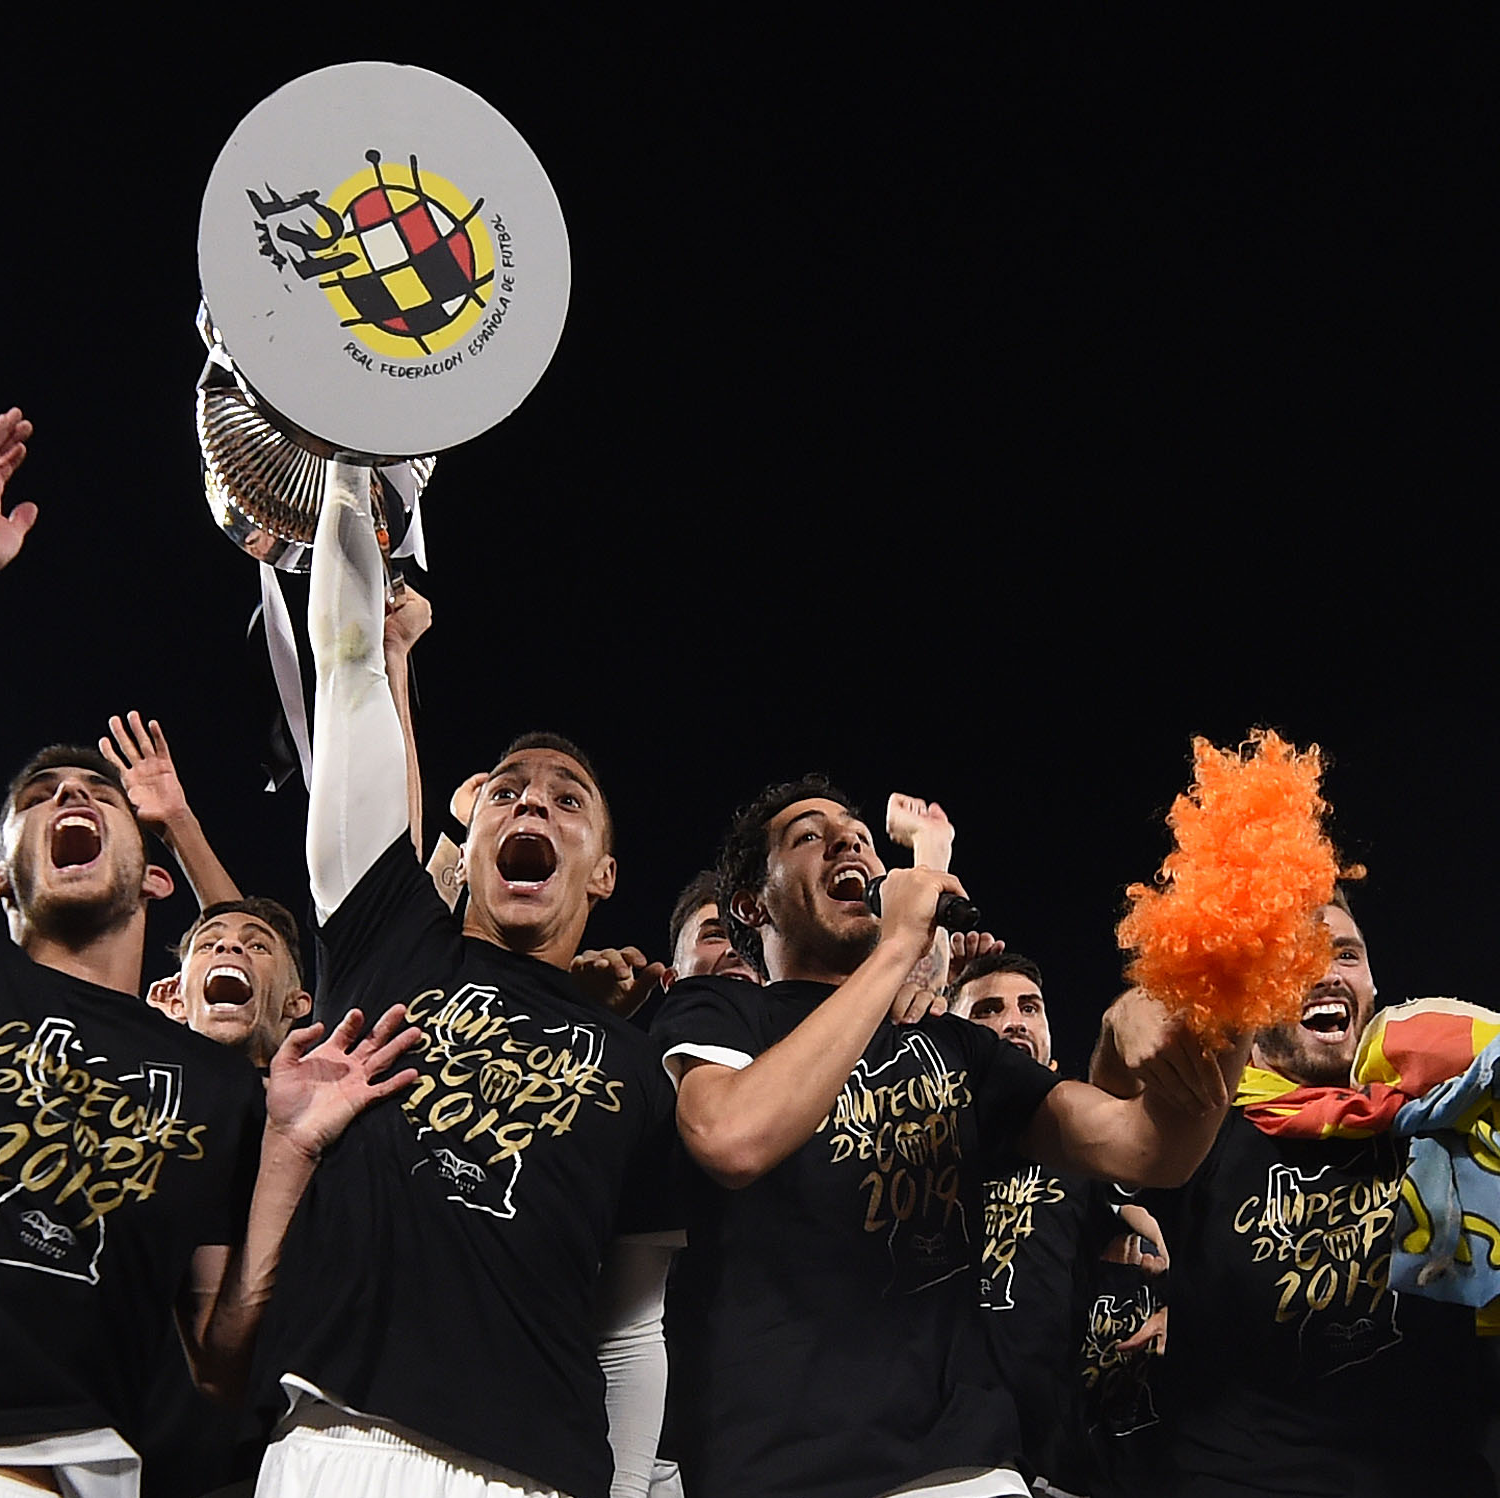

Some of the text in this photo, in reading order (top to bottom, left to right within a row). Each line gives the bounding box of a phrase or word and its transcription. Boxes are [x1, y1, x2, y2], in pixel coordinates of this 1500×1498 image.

[343, 213, 518, 380] REAL FEDERACION ESPAÑOLA DE FUTBOL
[401, 1074, 536, 1166] 2019
[830, 1133, 874, 1164] DE
[859, 1165, 960, 1233] 2019
[1251, 1236, 1292, 1262] DE
[1274, 1252, 1392, 1323] 2019
